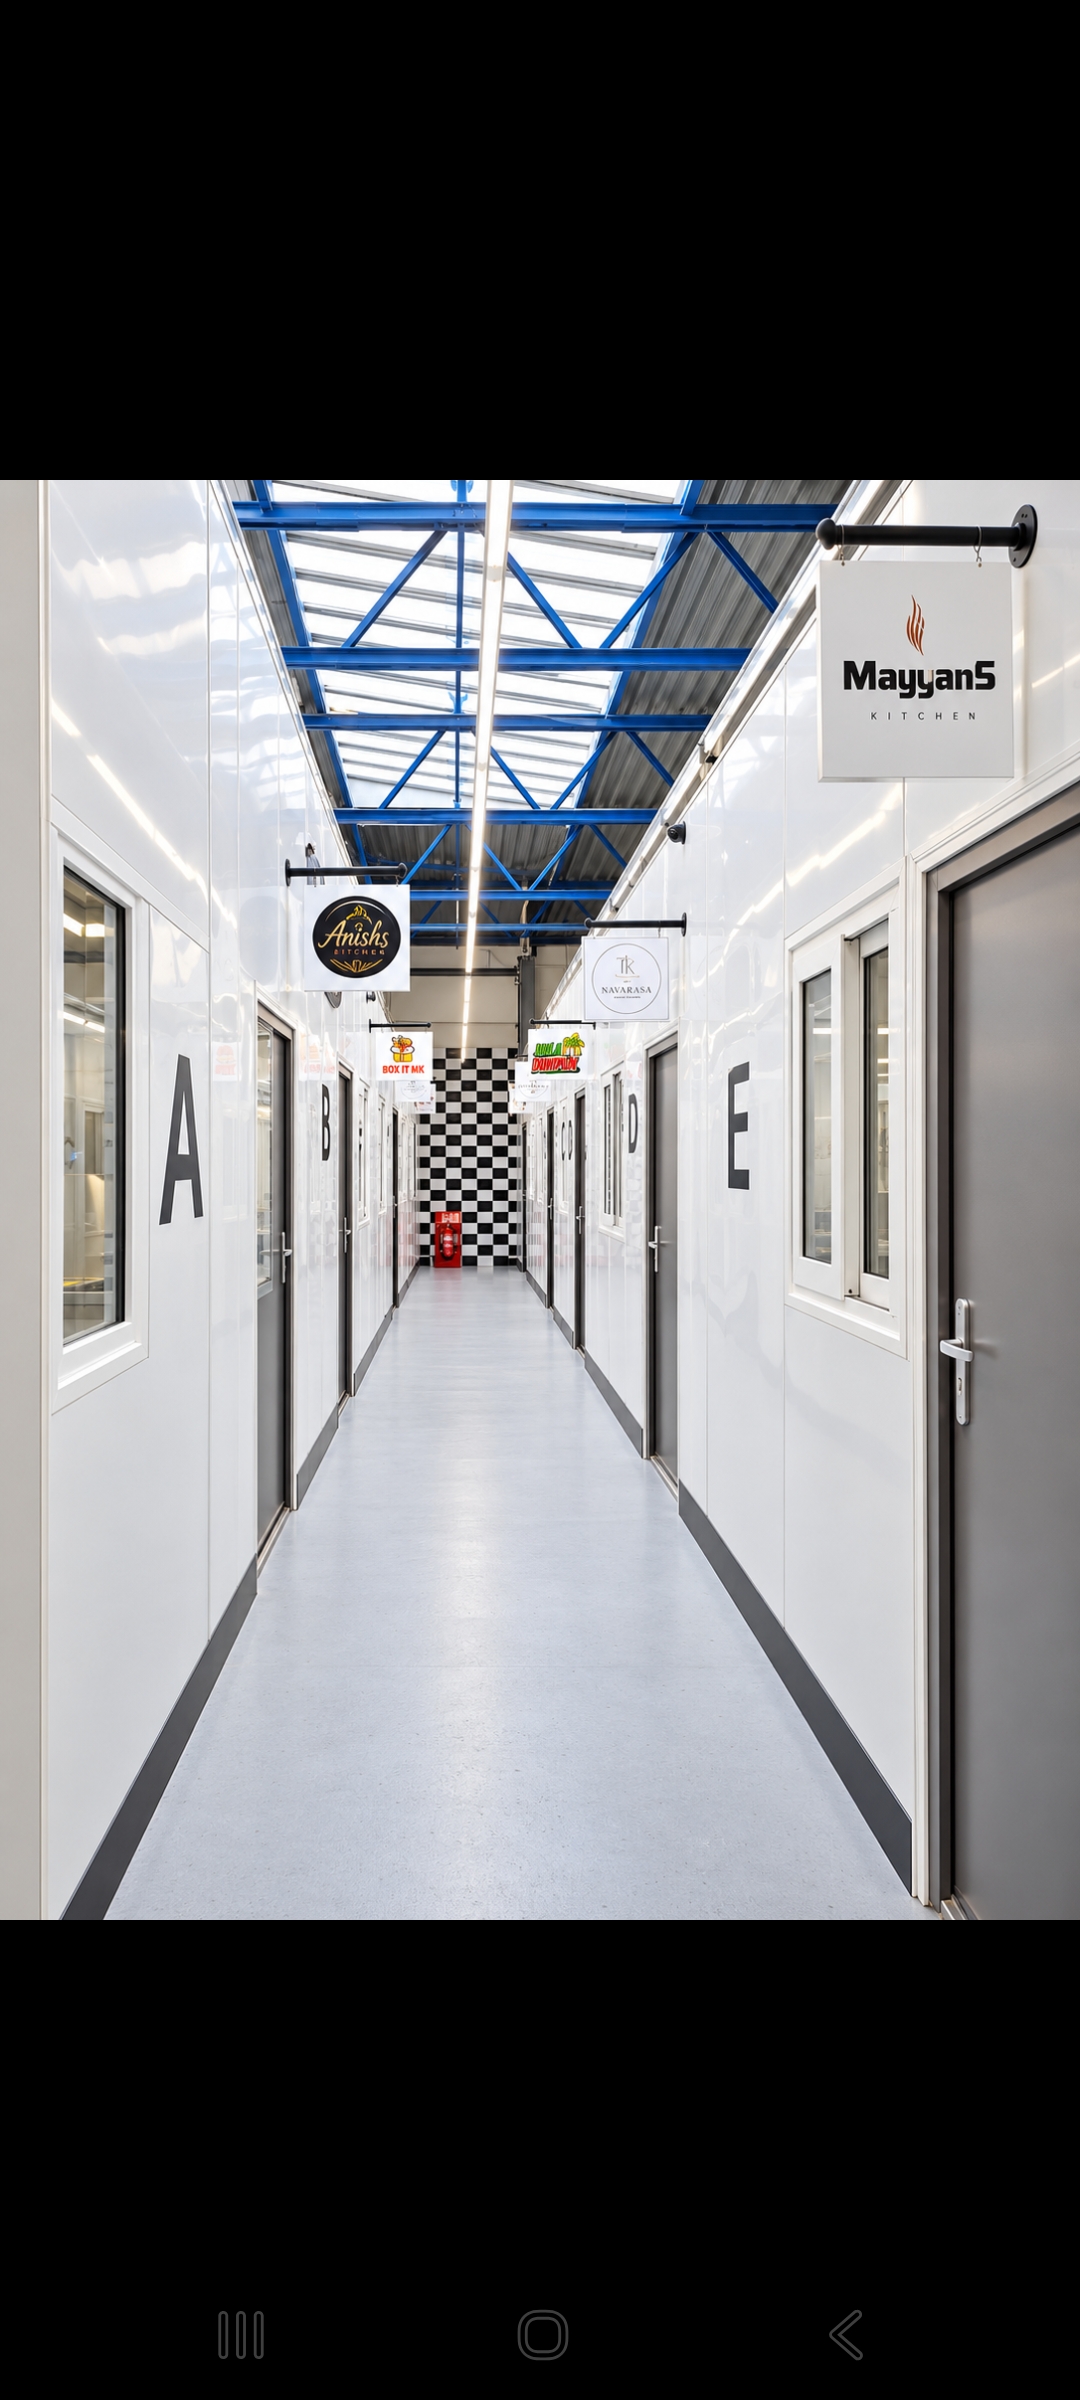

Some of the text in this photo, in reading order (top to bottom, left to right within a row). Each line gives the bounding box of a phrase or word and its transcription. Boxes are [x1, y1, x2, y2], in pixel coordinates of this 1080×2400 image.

[870, 711, 976, 721] KITCHEN
[317, 919, 389, 948] Anishs
[601, 986, 652, 994] NAVARASA
[382, 1065, 425, 1073] BOX IT MK
[159, 1053, 203, 1225] A
[321, 1083, 330, 1161] B
[628, 1093, 639, 1154] D
[728, 1061, 750, 1191] E
